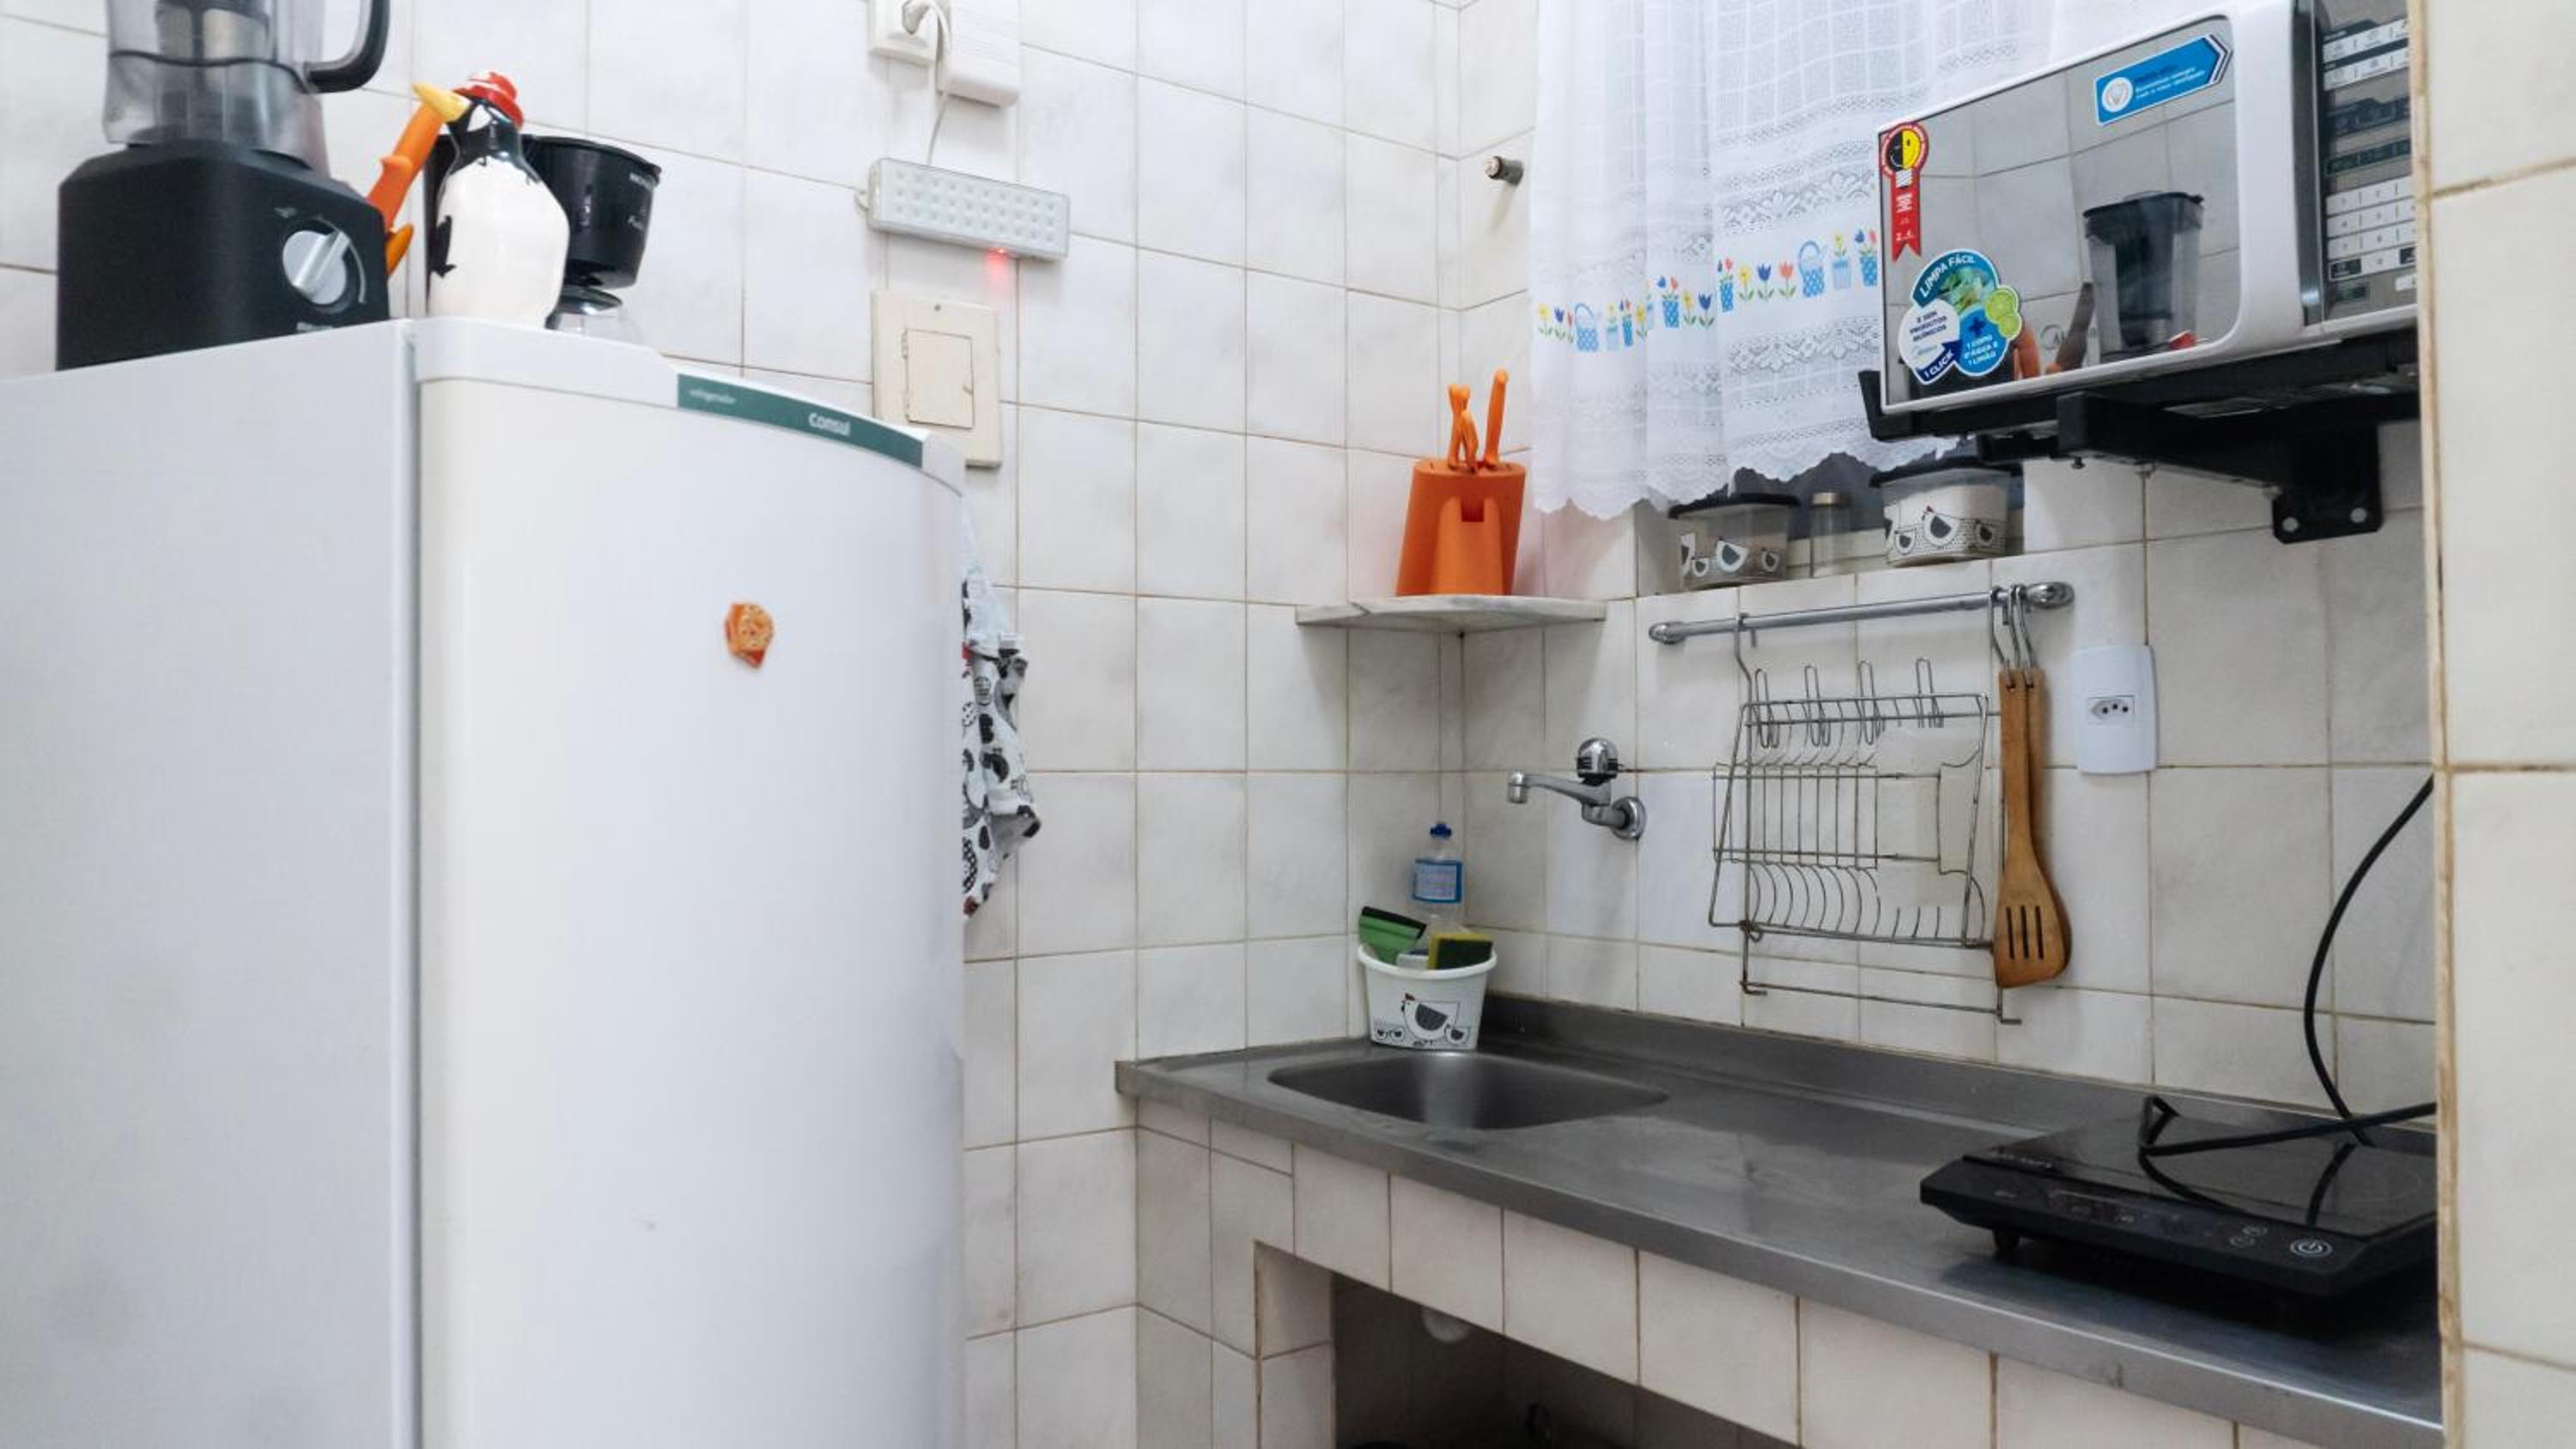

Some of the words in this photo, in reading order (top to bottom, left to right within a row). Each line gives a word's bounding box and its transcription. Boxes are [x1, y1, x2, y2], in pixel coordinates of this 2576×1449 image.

[1919, 262, 1948, 298] LIMPA
[1947, 254, 1976, 268] FÁCIL
[1923, 370, 1930, 379] 1
[1929, 351, 1954, 376] CLICK
[809, 412, 851, 436] Consul
